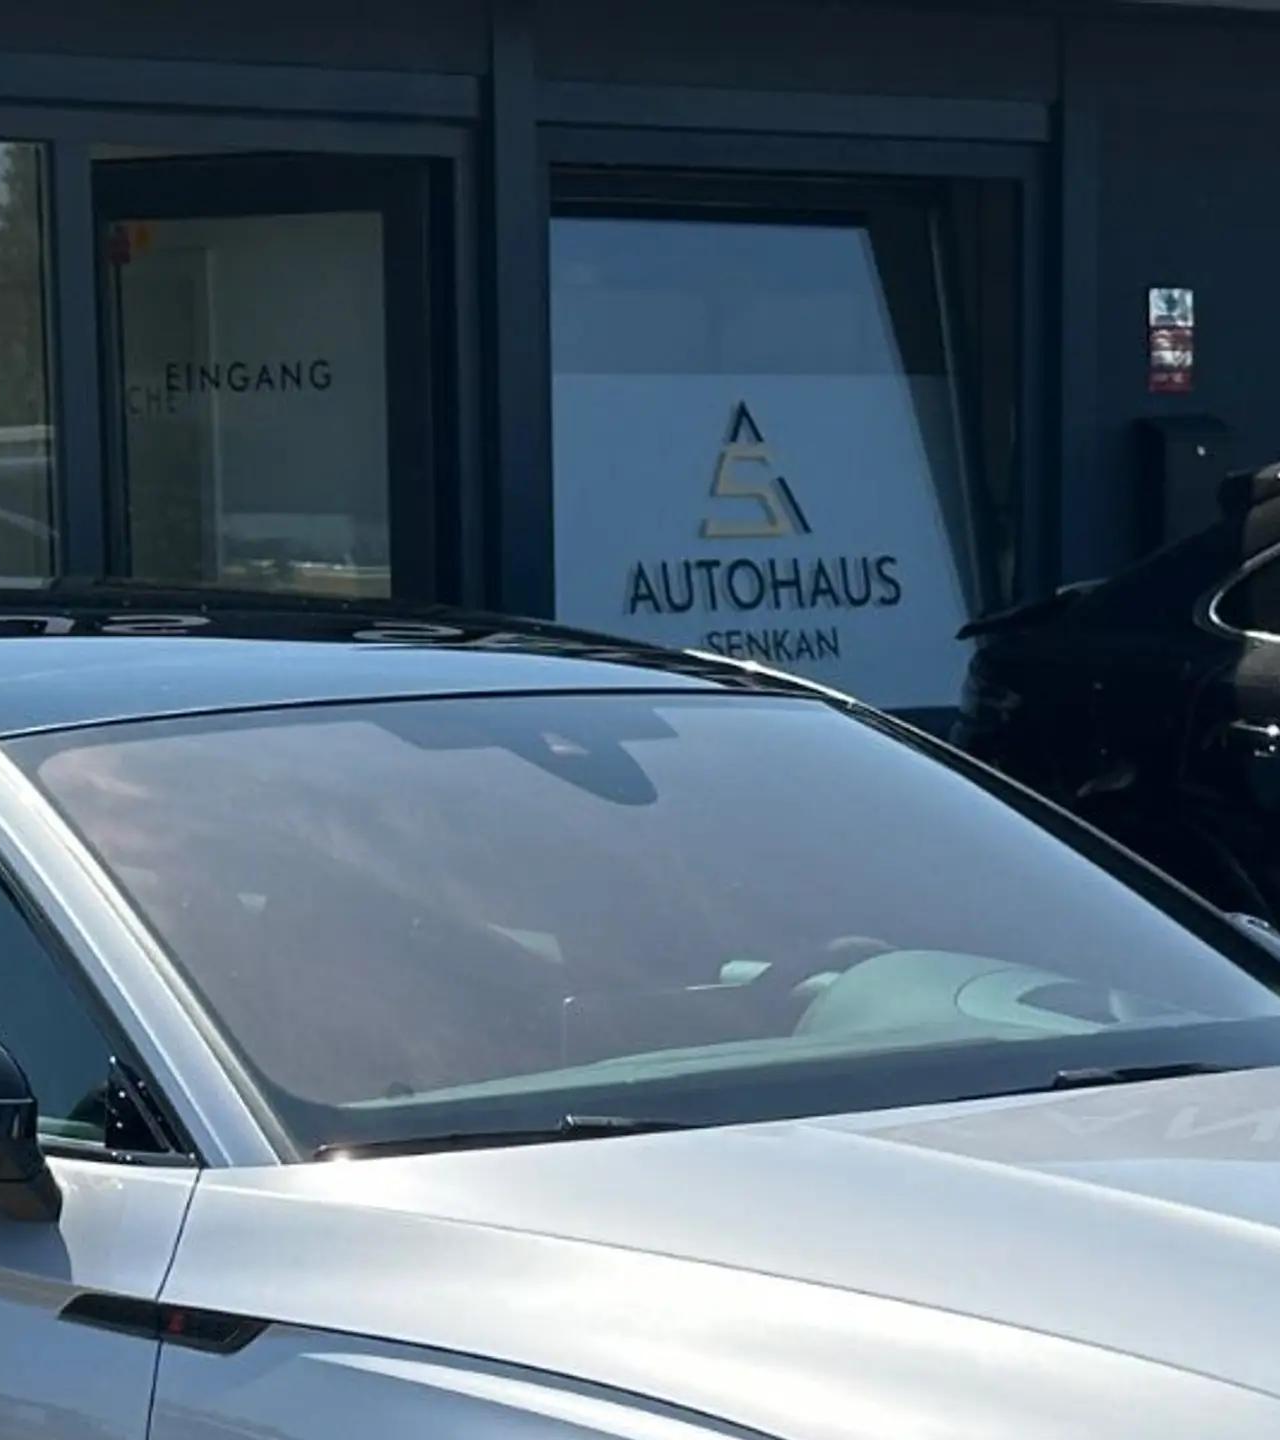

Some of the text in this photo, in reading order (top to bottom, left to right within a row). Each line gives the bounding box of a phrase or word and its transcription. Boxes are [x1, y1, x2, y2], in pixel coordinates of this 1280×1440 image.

[165, 359, 333, 393] EINGANG
[628, 555, 902, 615] AUTOHAUS
[704, 627, 840, 662] SENKAN
